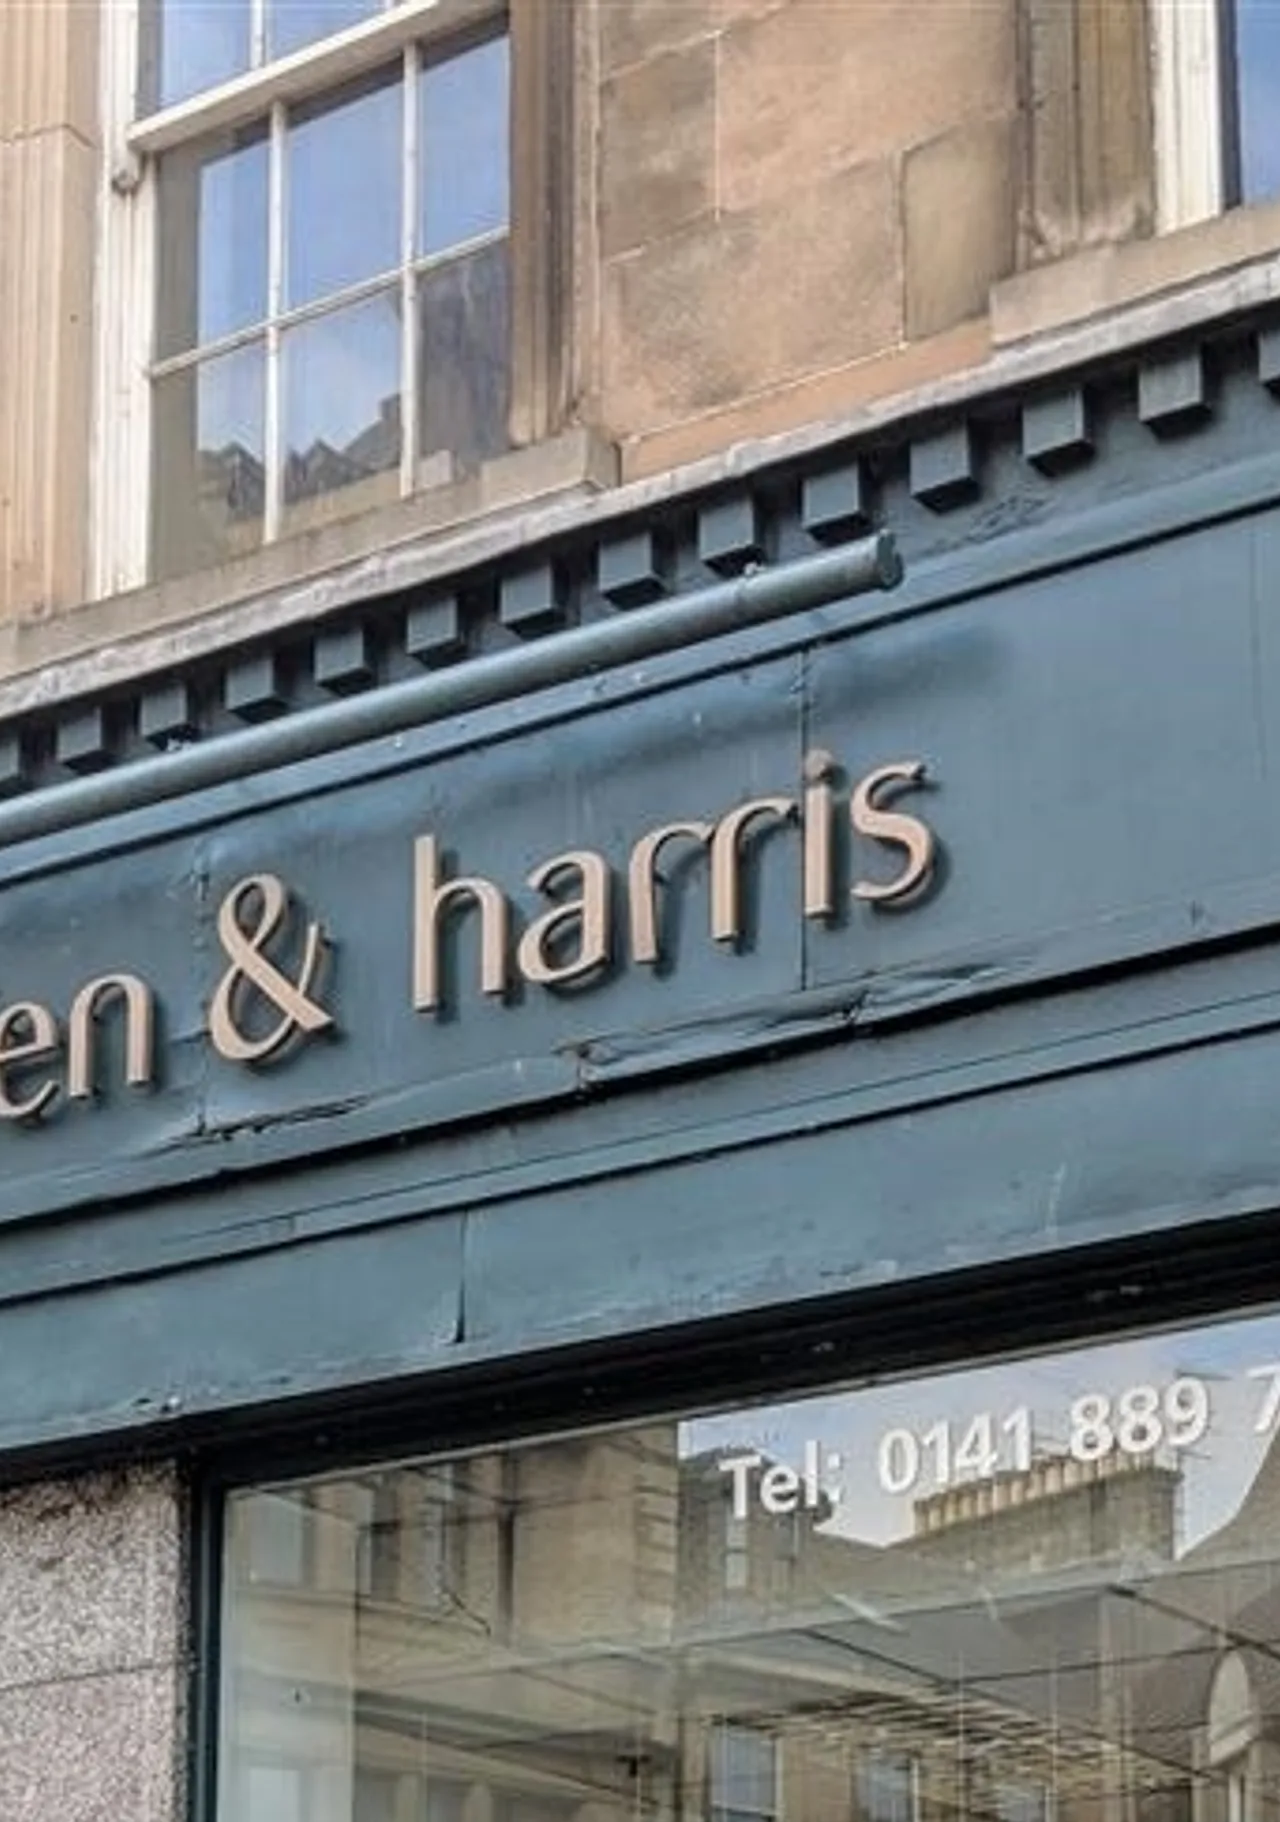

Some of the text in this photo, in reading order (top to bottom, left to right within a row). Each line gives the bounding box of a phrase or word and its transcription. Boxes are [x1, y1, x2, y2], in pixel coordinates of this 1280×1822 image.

[209, 872, 333, 1067] &
[413, 750, 937, 1013] harris
[878, 1409, 1034, 1495] 0141
[1069, 1375, 1210, 1461] 889
